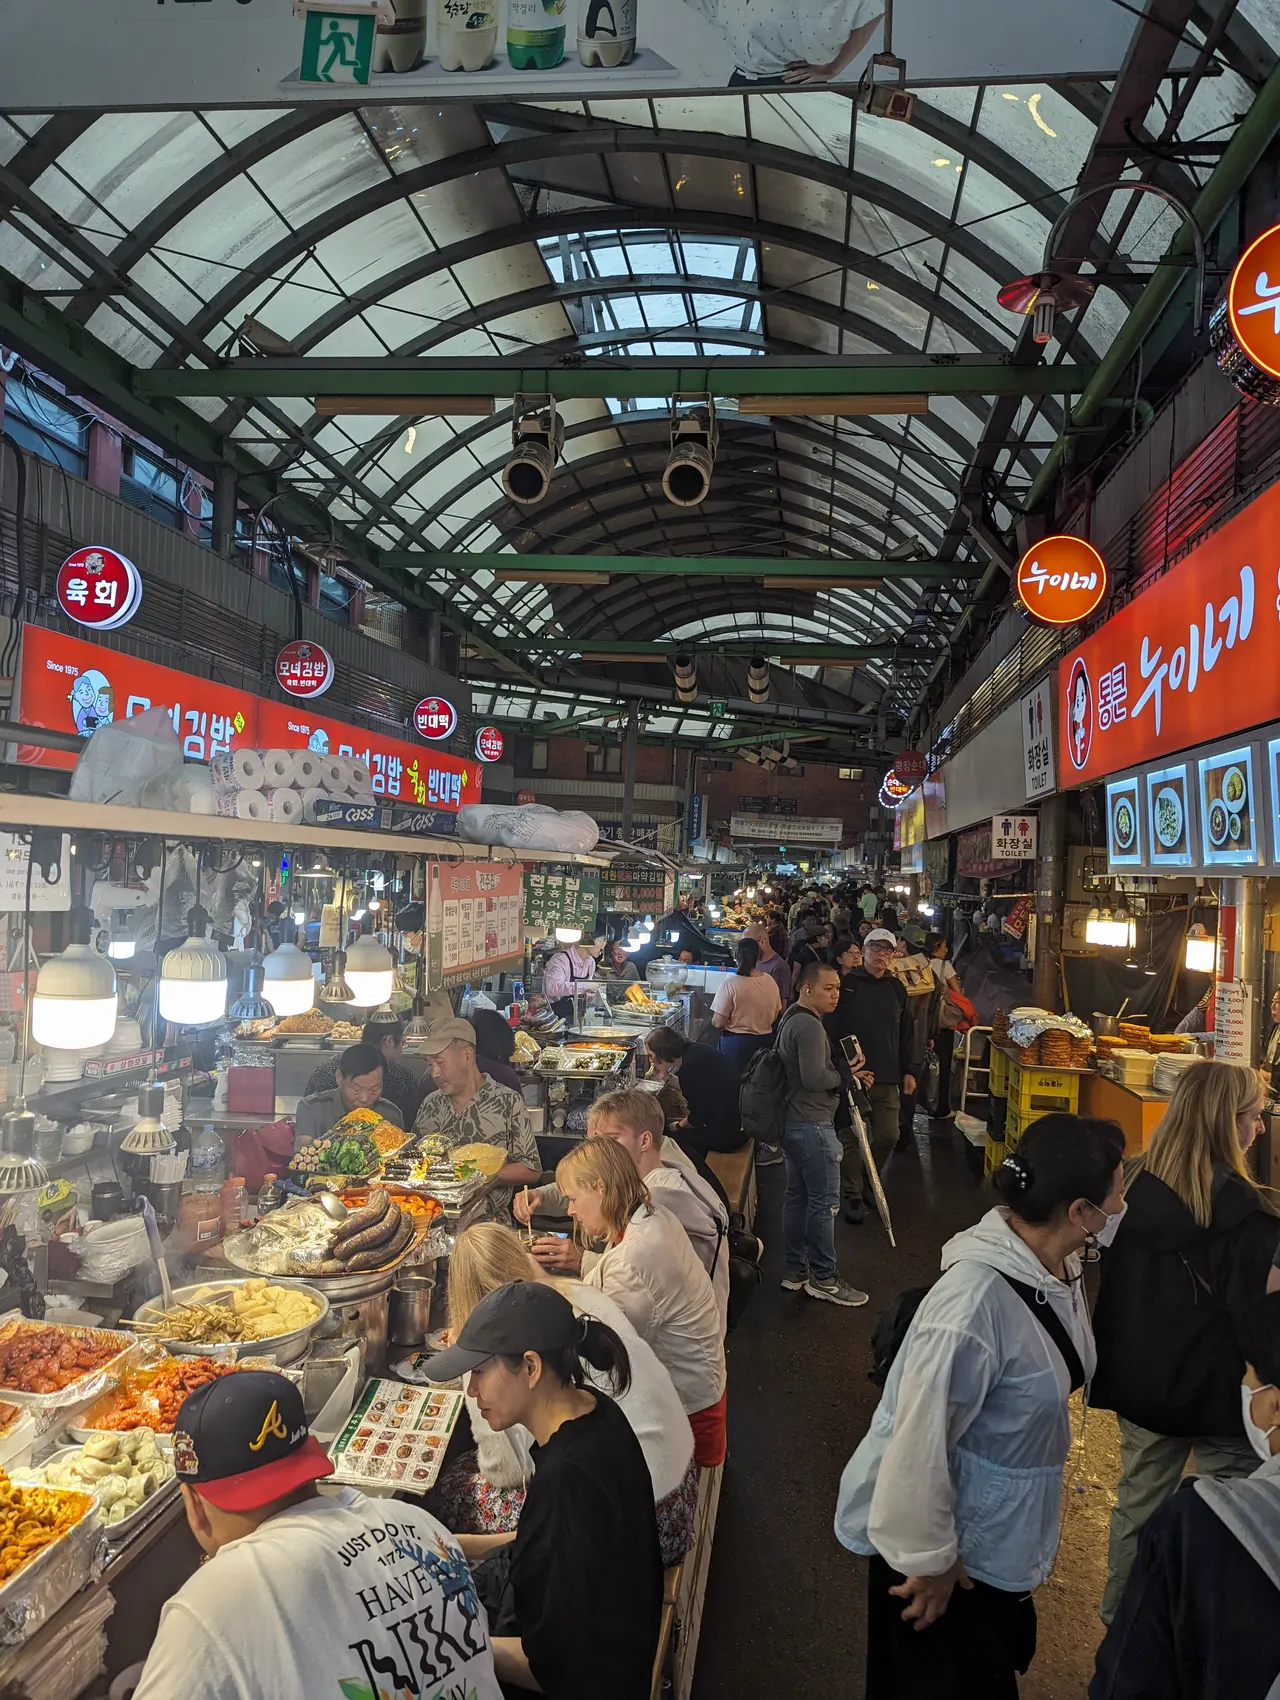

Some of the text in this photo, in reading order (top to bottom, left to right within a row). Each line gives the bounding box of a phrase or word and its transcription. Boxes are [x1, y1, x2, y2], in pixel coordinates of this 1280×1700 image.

[512, 3, 536, 14] 막걸리
[1098, 661, 1127, 731] 통큰
[1131, 565, 1256, 737] 누이네
[46, 659, 79, 677] Since 1975
[279, 661, 326, 677] 모녀김밥
[126, 694, 235, 760] 김밥
[287, 721, 300, 733] Since
[417, 714, 449, 730] 빈대떡
[1027, 737, 1049, 772] 화장실
[338, 744, 403, 796] 김밥
[427, 768, 462, 807] 빈대떡
[1031, 771, 1047, 791] TOILET
[996, 838, 1033, 849] 화장실
[601, 870, 616, 880] 대원
[633, 871, 664, 883] 마약김밥
[249, 1400, 288, 1452] A
[337, 1523, 421, 1568] JUST DO IT.
[355, 1559, 455, 1622] HAVE A
[348, 1585, 487, 1700] NIKE
